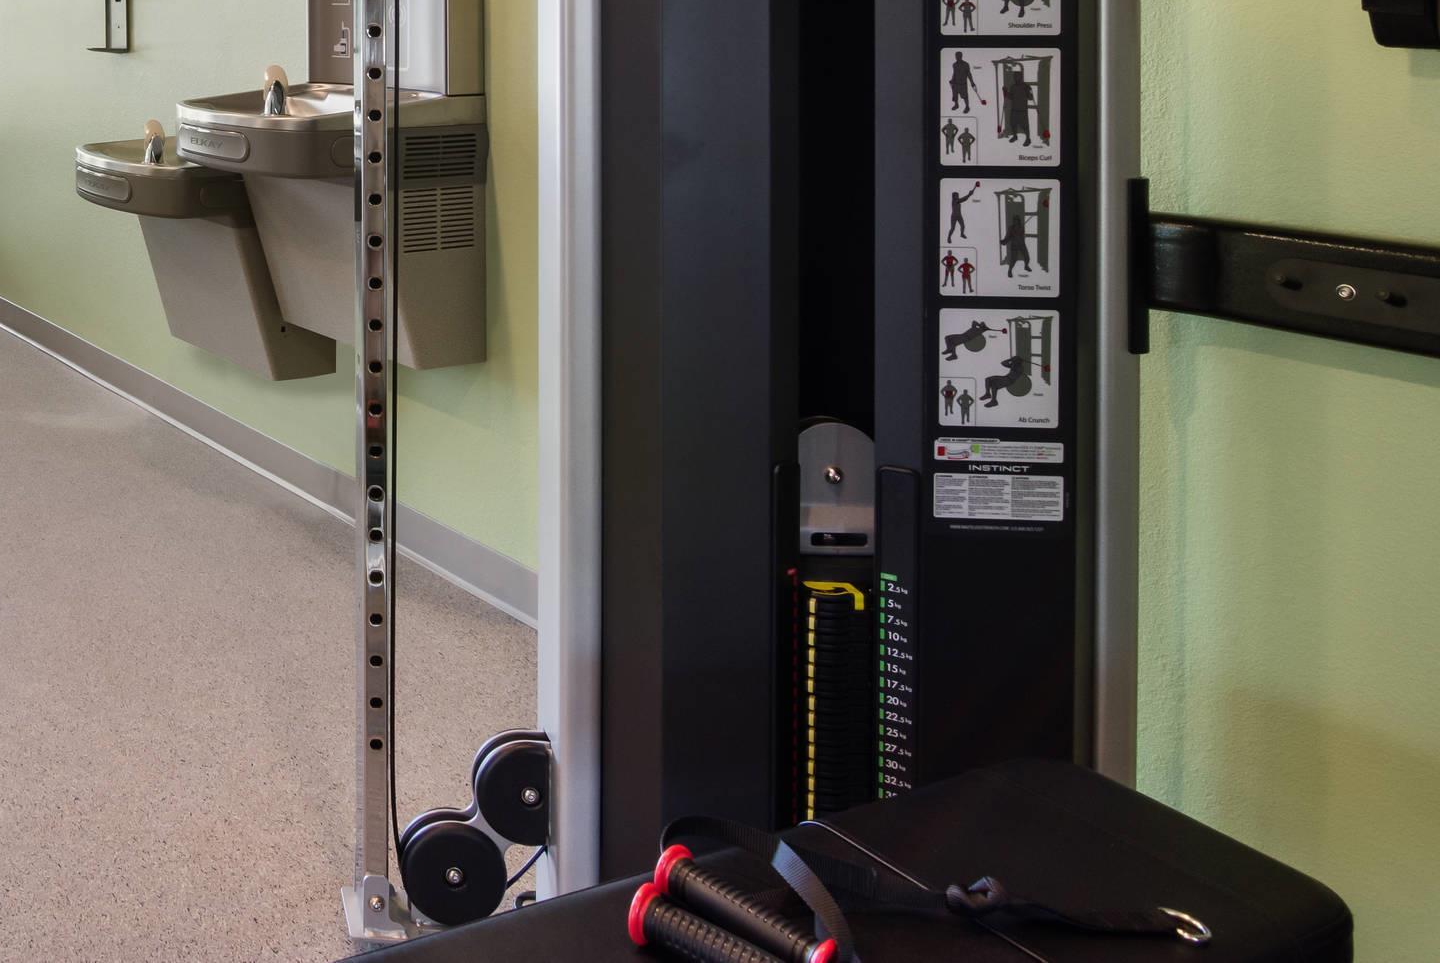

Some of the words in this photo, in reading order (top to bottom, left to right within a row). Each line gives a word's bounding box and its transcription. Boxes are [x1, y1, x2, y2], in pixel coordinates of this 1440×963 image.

[191, 136, 224, 148] ELKAY
[1028, 416, 1050, 424] Crunch
[968, 464, 1030, 473] INSTINCT
